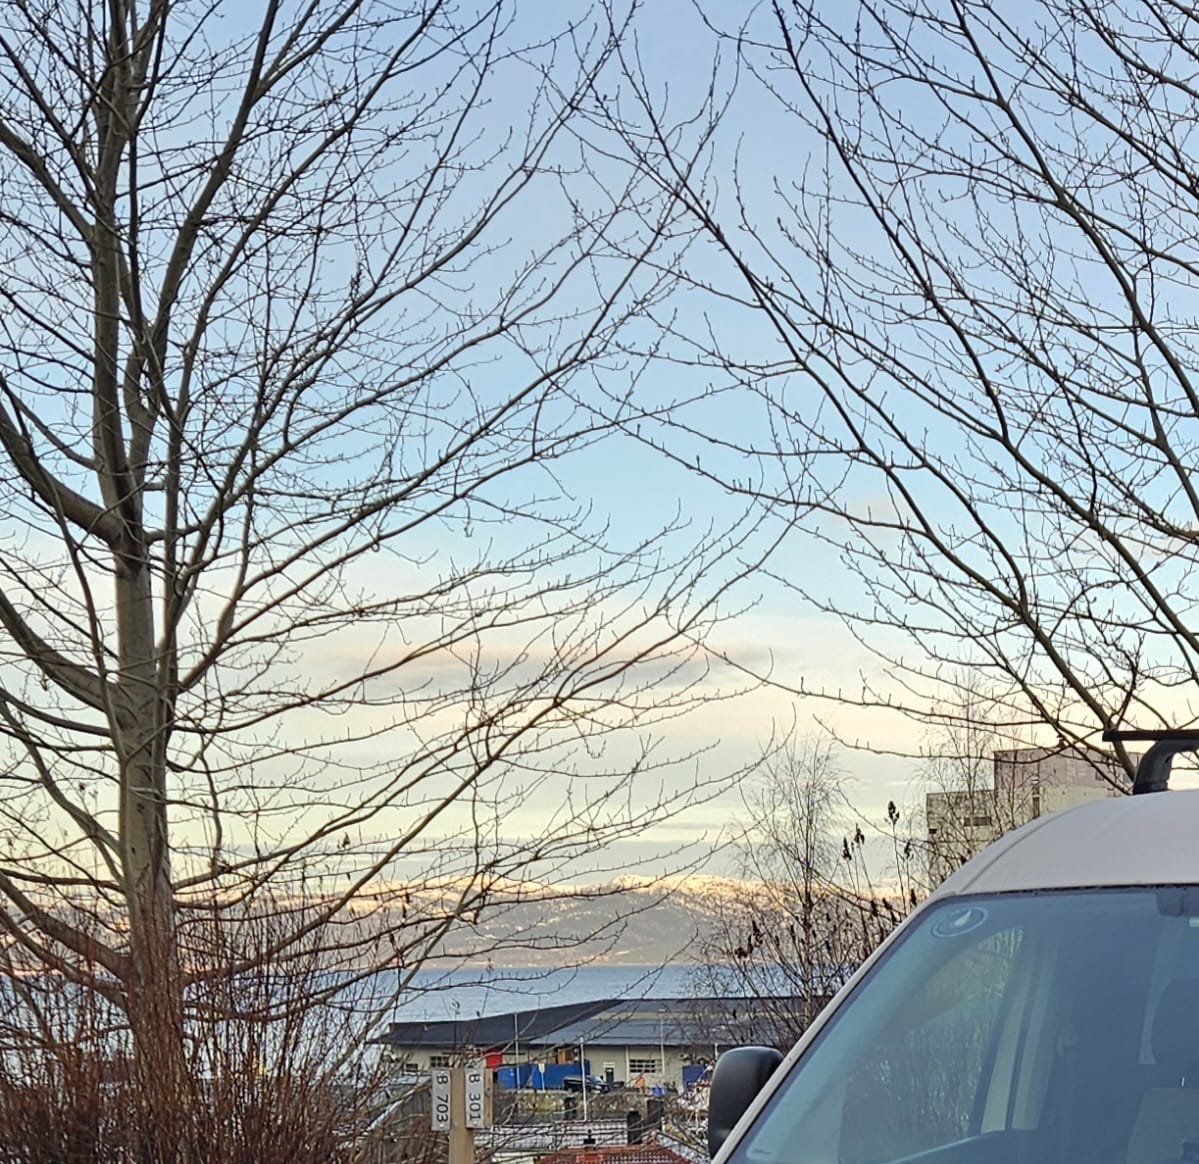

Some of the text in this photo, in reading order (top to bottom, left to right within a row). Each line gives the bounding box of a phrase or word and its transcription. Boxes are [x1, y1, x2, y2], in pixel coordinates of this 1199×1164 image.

[436, 1075, 448, 1123] B 703
[469, 1073, 481, 1122] B 301
